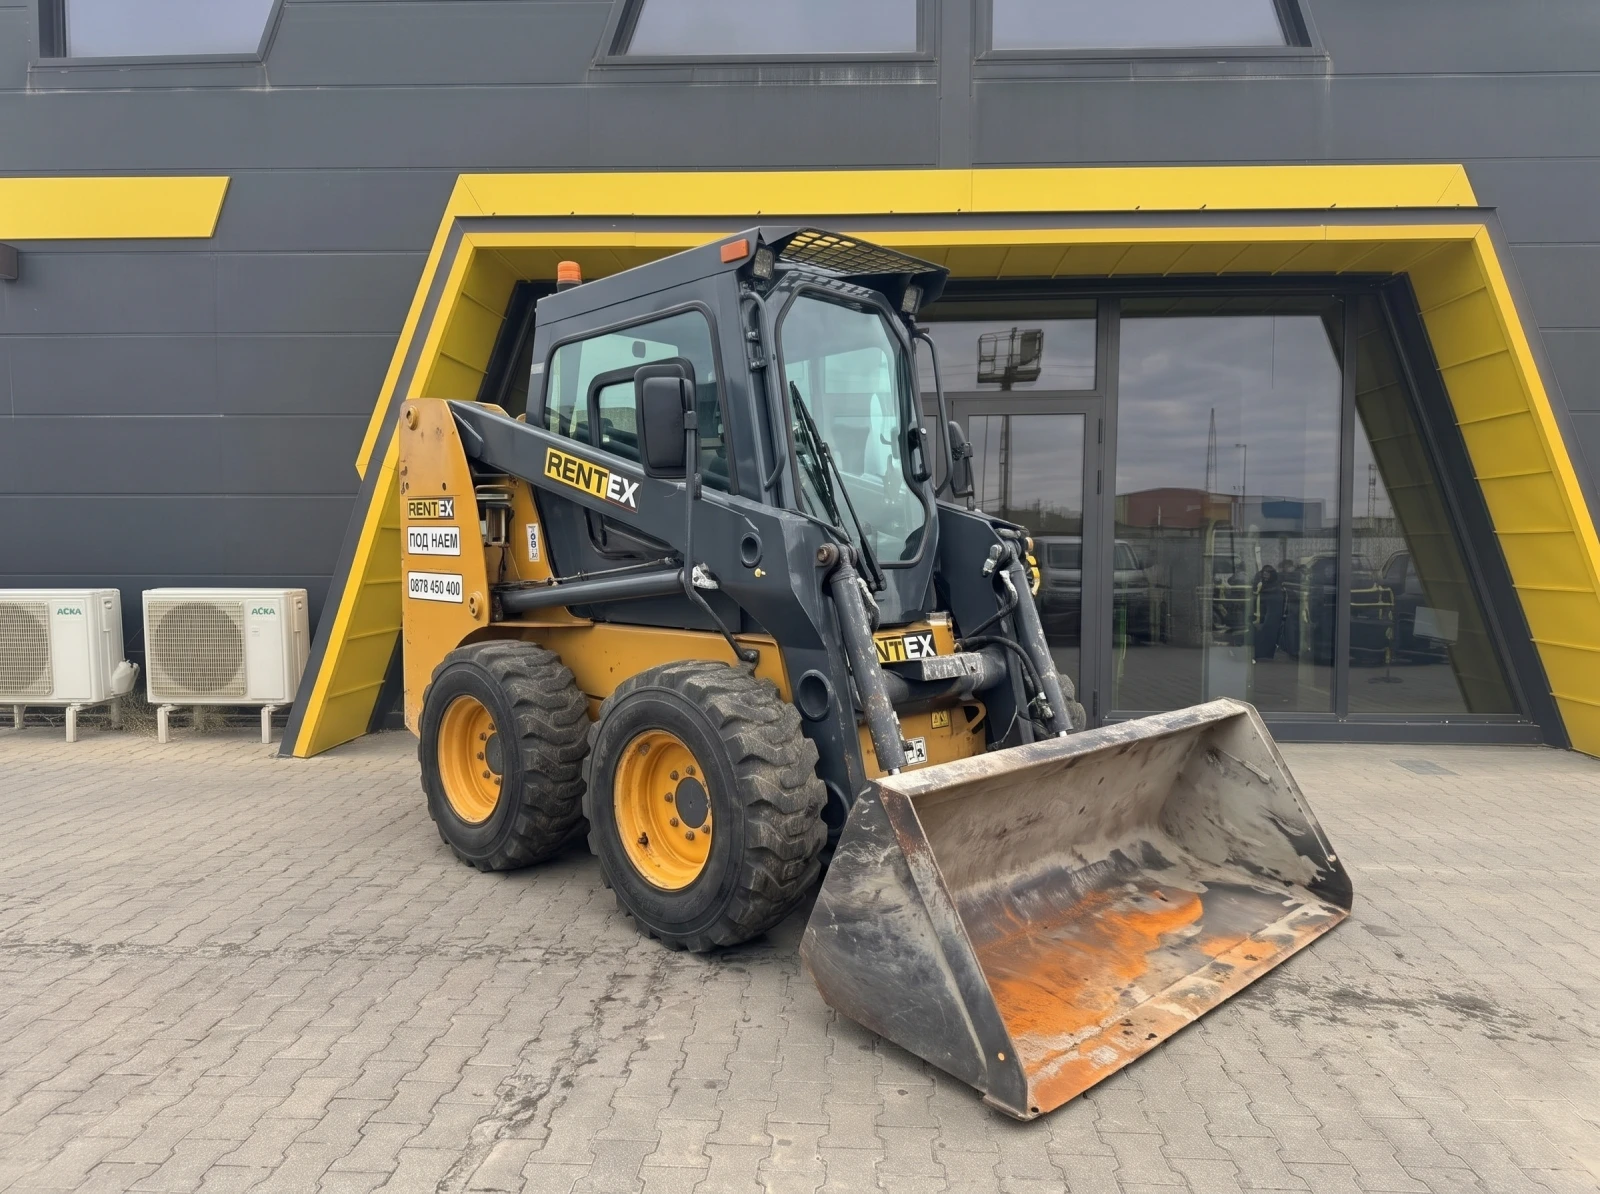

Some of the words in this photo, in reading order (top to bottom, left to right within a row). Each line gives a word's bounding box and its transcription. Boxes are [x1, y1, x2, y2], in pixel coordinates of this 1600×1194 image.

[547, 451, 640, 508] RENTEX
[408, 500, 453, 517] RENTEX
[409, 533, 429, 551] ПОД
[431, 533, 458, 548] НАЕМ
[410, 578, 429, 593] 0878
[430, 580, 444, 595] 450
[445, 581, 460, 596] 400
[875, 634, 936, 661] NTEX
